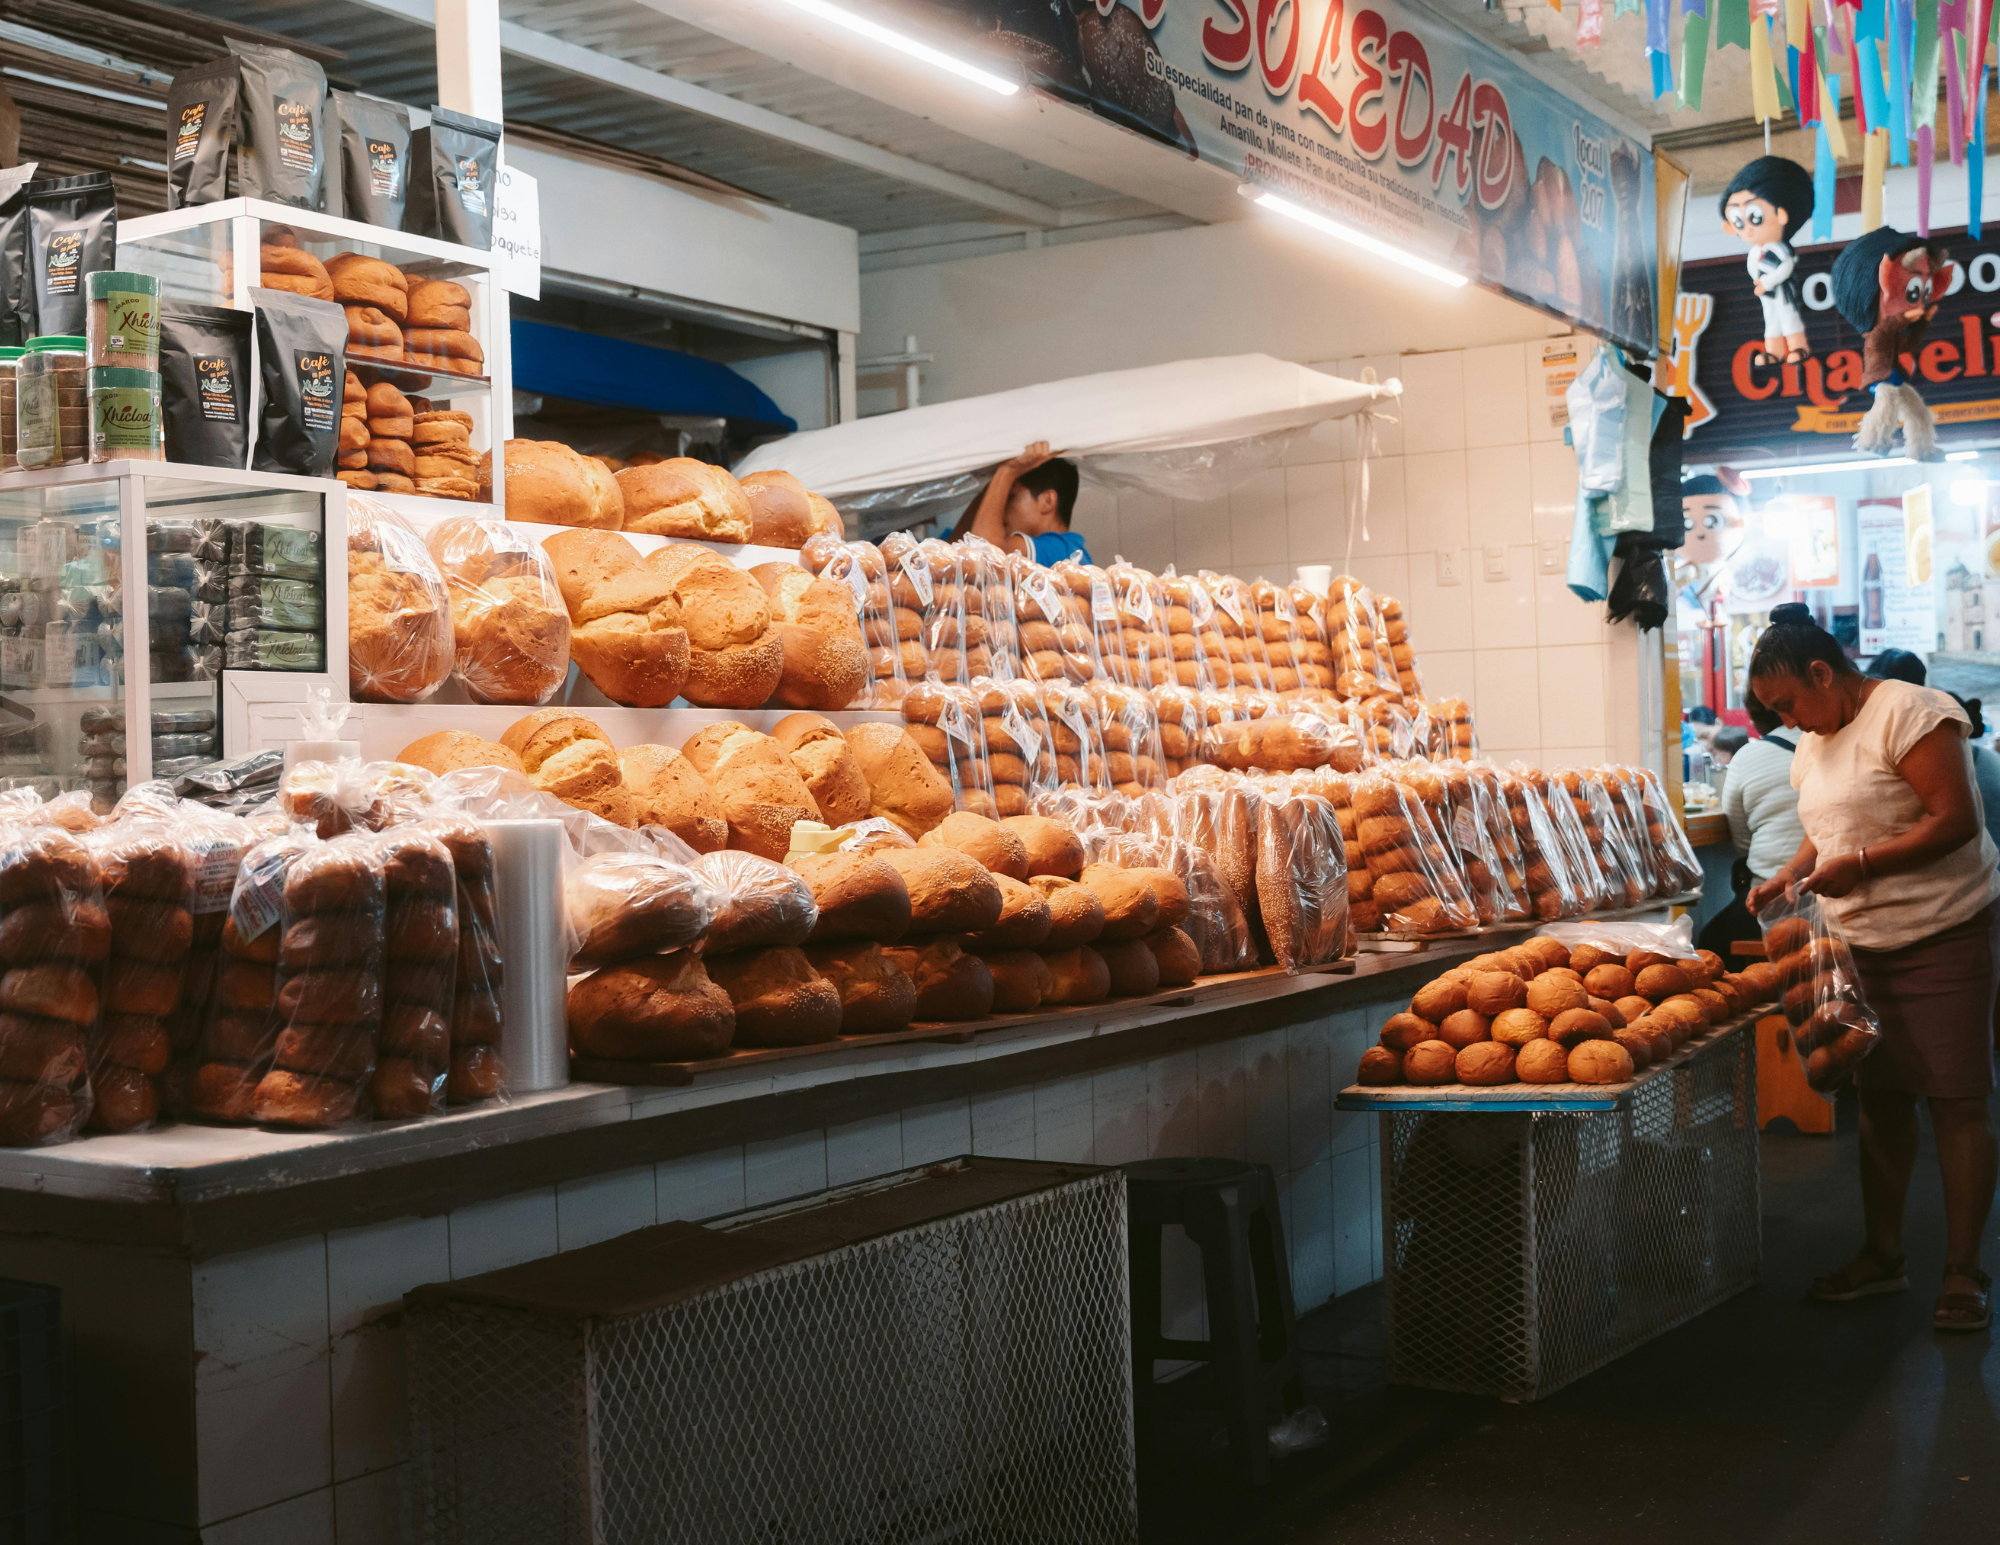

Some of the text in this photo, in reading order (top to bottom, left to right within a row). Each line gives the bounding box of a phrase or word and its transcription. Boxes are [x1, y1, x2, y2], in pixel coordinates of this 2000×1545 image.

[1146, 51, 1162, 76] Su
[1165, 65, 1232, 111] especialidad
[1235, 100, 1253, 121] pan
[1256, 109, 1268, 129] de
[1270, 119, 1295, 143] yema
[1298, 133, 1315, 153] con
[1317, 142, 1366, 178] mantequilla
[1368, 168, 1378, 183] su
[1380, 173, 1420, 204] tradicional
[1422, 196, 1435, 212] pan
[1220, 114, 1266, 155] Amarillo,
[1305, 156, 1322, 179] Pan
[1325, 167, 1336, 185] de
[1338, 172, 1370, 204] Cazuela
[1373, 193, 1378, 209] y
[1581, 184, 1604, 231] 207
[101, 405, 155, 429] Xhicloat
